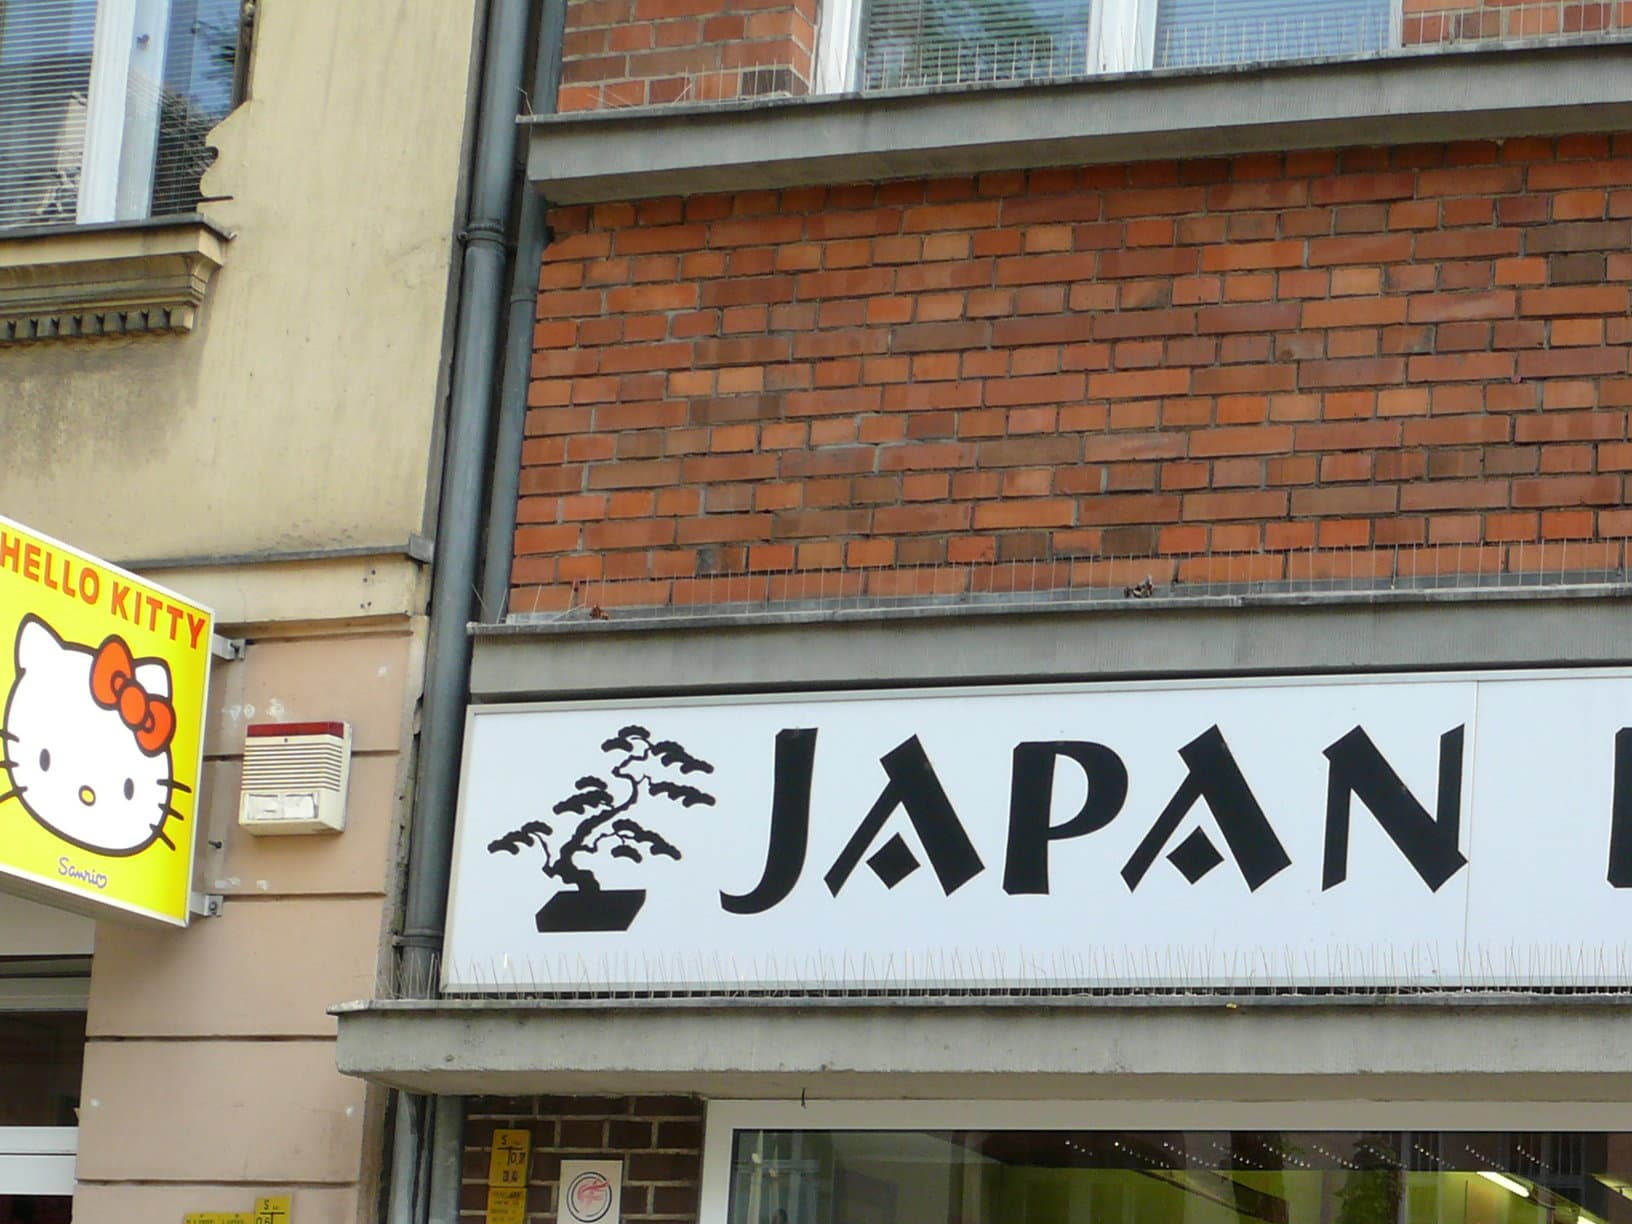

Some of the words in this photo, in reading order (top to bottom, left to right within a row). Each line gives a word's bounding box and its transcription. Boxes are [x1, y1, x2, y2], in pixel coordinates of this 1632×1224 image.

[0, 531, 100, 605] HELLO
[110, 580, 206, 650] KITTY
[58, 857, 107, 889] Sanrio
[719, 723, 1469, 915] JAPAN
